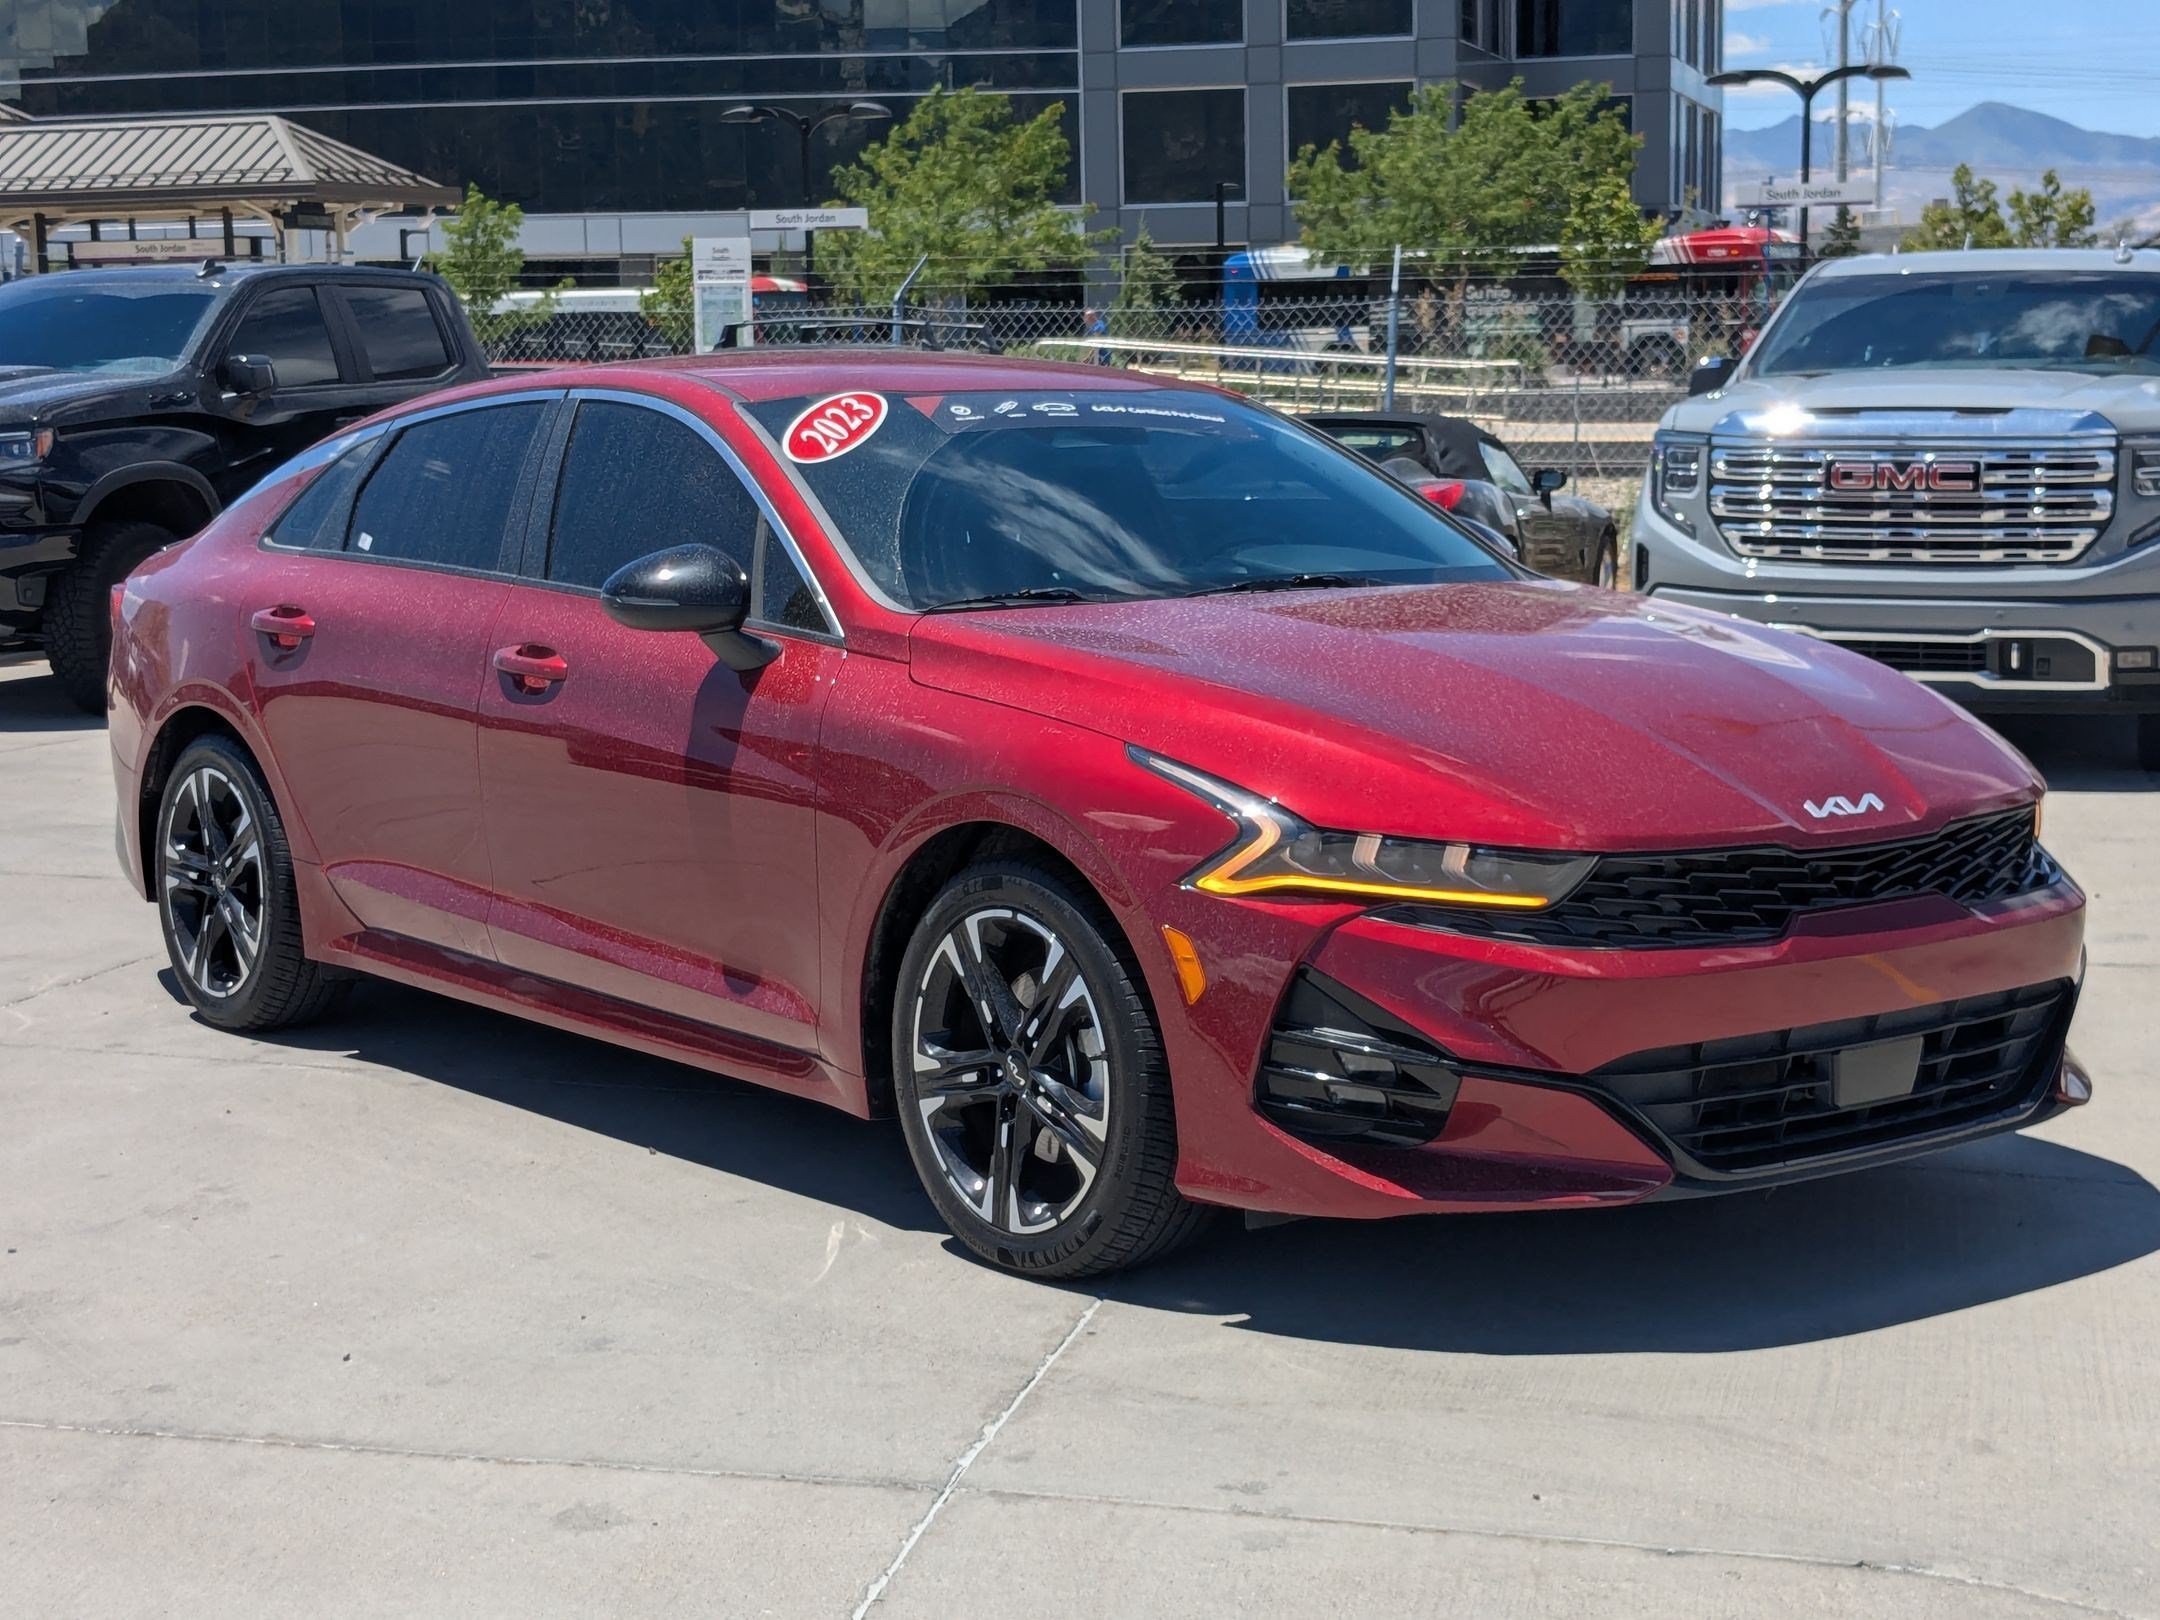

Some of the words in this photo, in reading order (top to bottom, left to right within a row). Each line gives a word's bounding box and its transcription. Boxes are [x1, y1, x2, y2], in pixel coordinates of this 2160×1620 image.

[1766, 189, 1800, 200] South
[1803, 187, 1841, 199] Jordan
[775, 214, 803, 224] South
[804, 213, 836, 223] Jordan
[135, 244, 159, 253] South
[160, 244, 187, 253] Jordan
[800, 397, 874, 454] 2023
[1830, 462, 1976, 490] GMC
[1803, 792, 1885, 818] KIA
